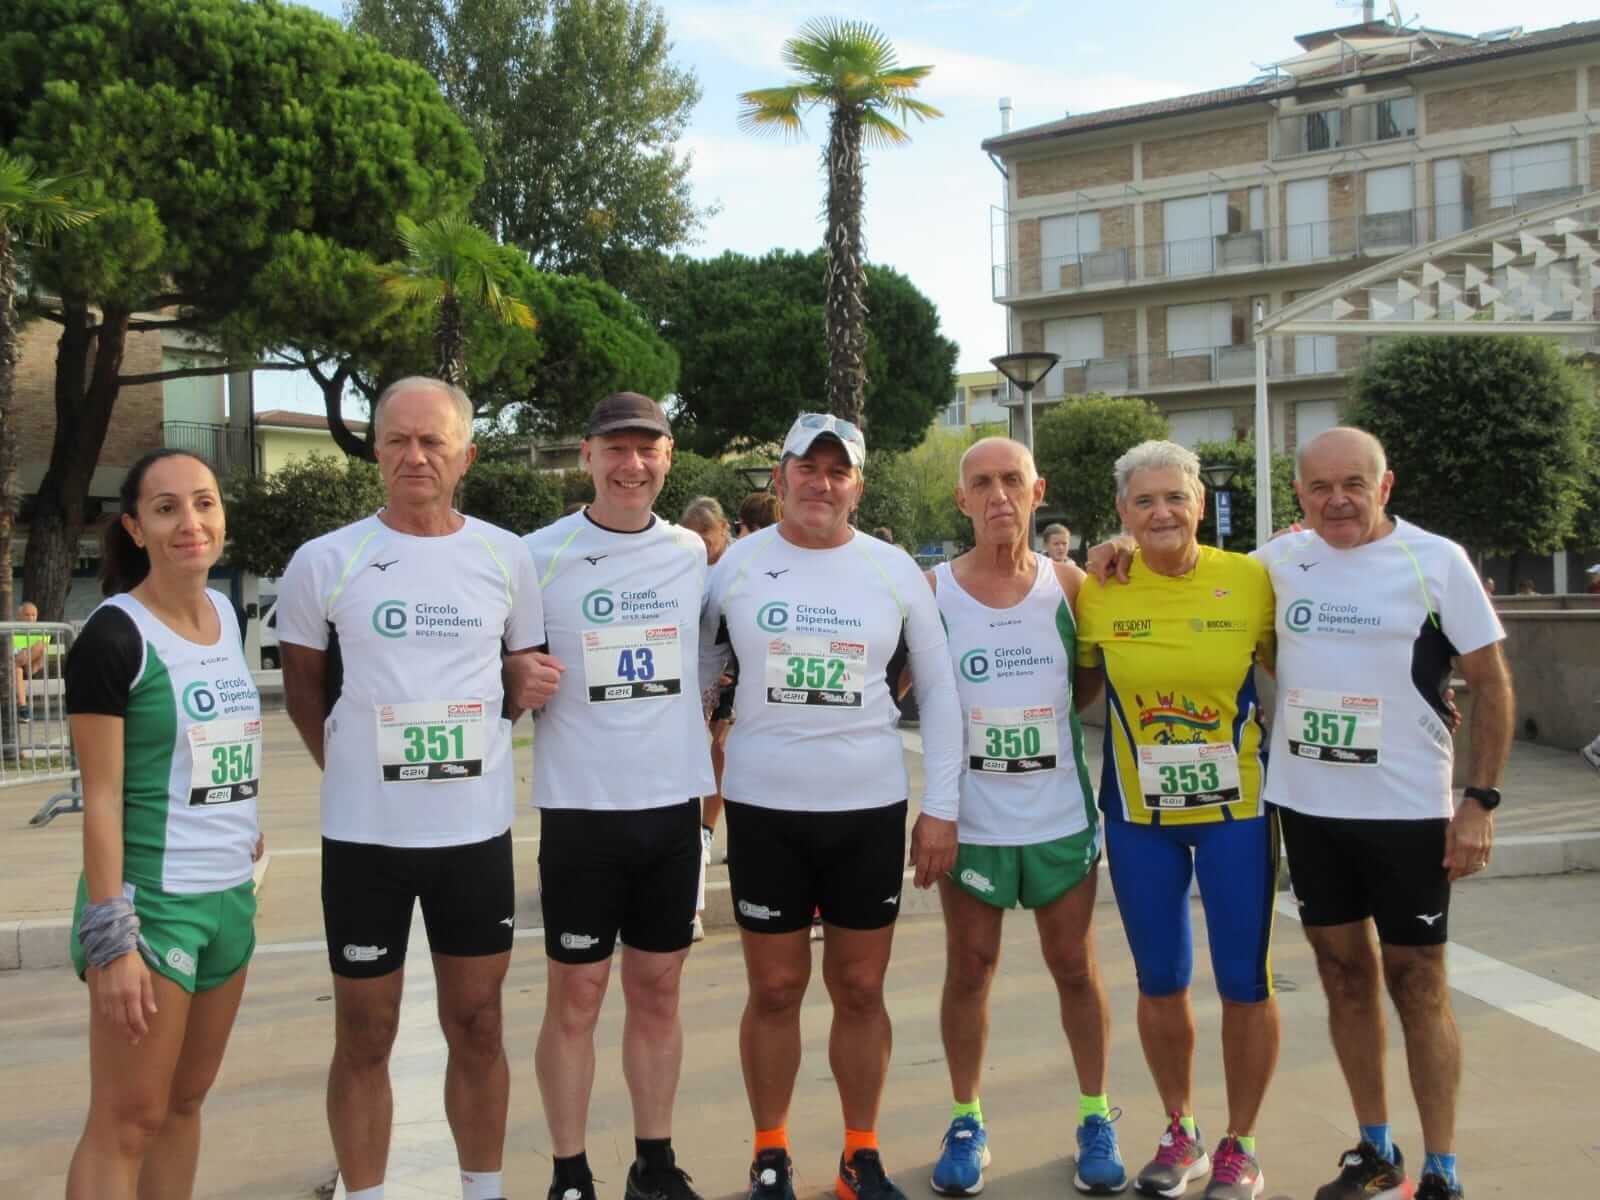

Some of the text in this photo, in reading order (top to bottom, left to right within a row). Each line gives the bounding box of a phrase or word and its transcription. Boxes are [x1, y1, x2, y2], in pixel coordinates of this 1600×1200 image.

[621, 589, 657, 600] Circolo
[415, 603, 458, 614] Circolo
[621, 599, 679, 612] Dipendenti
[796, 605, 837, 615] Circolo
[1320, 602, 1358, 614] Circolo
[415, 615, 482, 628] Dipendenti
[796, 614, 862, 627] Dipendenti
[1318, 612, 1381, 626] Dipendenti
[994, 646, 1032, 657] Circolo
[618, 648, 655, 681] 43
[995, 656, 1054, 669] Dipendenti
[786, 656, 845, 689] 352
[1303, 711, 1357, 745] 357
[403, 725, 464, 762] 351
[986, 727, 1040, 758] 350
[211, 744, 253, 784] 354
[1159, 763, 1219, 794] 353
